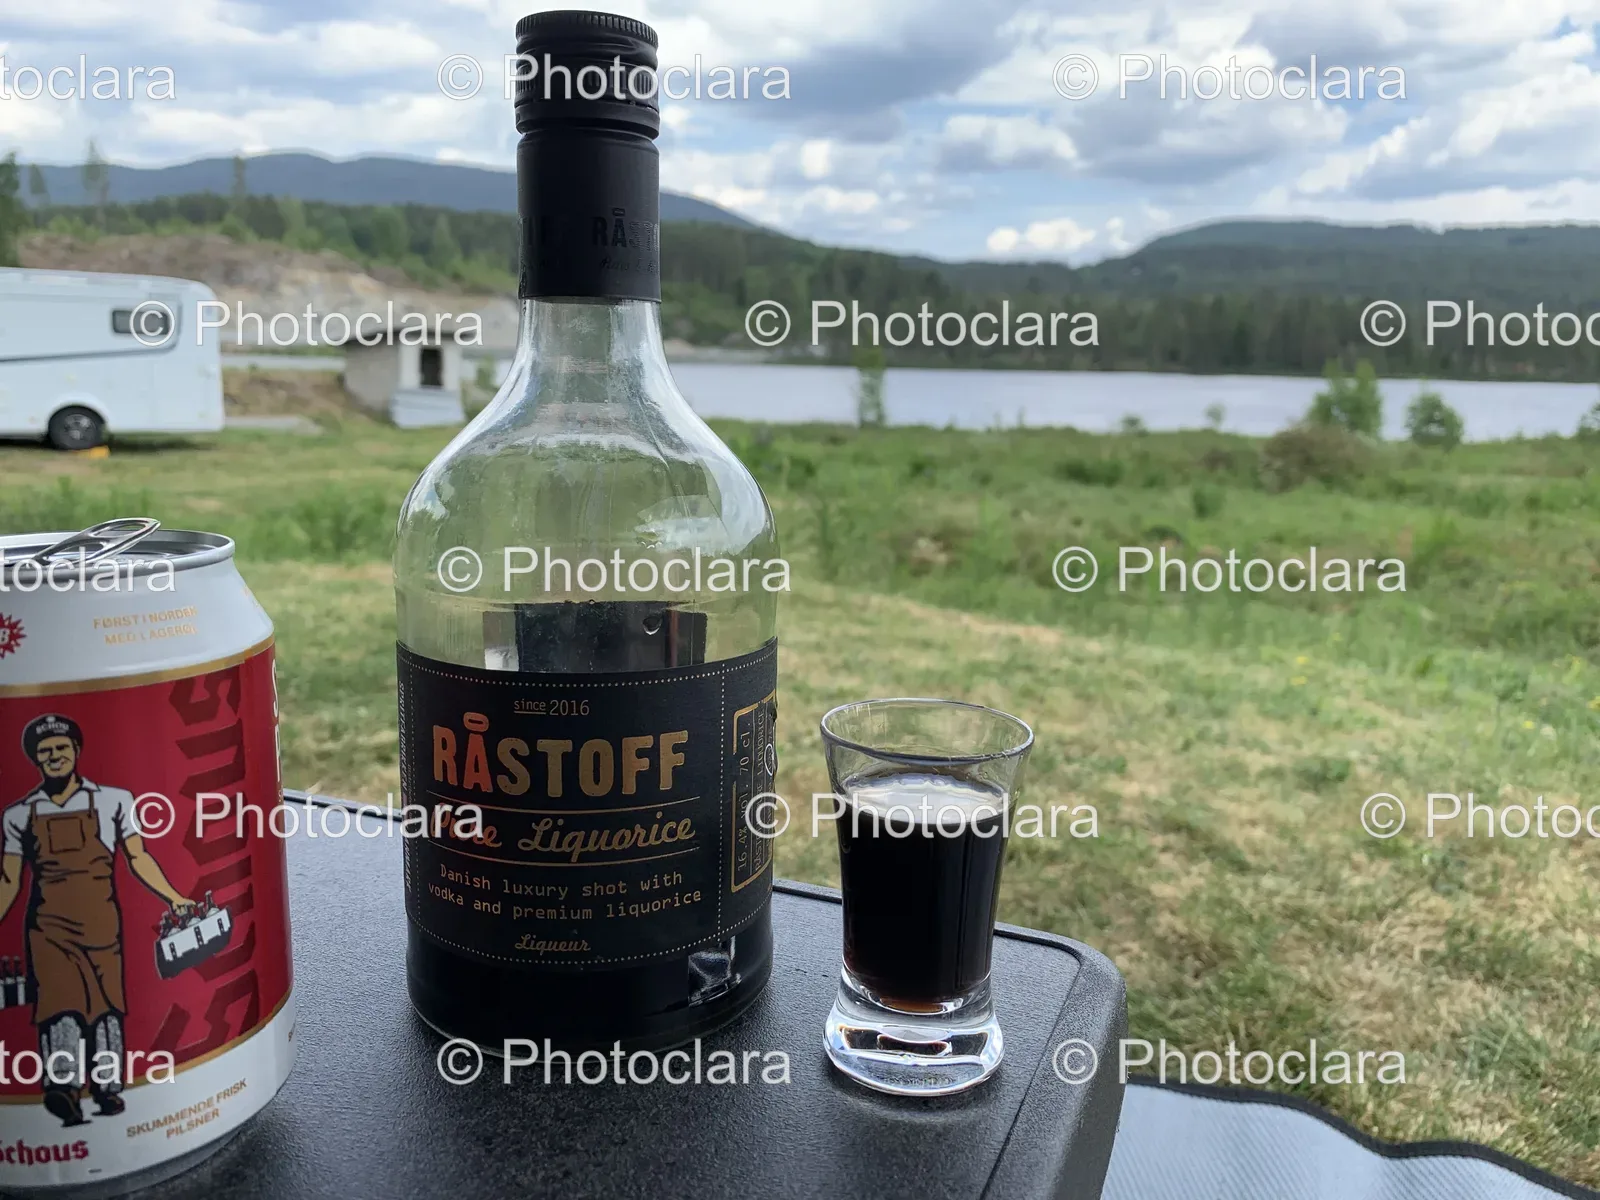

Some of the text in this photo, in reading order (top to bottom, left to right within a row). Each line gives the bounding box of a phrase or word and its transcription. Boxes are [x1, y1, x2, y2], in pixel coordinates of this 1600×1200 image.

[93, 614, 140, 630] FØRST
[104, 631, 136, 646] MED
[513, 698, 590, 716] since 2016
[740, 723, 751, 748] cl.
[432, 711, 689, 798] RÅSTOFF
[739, 756, 750, 776] 70
[430, 802, 696, 863] Pue Liquorice
[737, 826, 748, 872] 16.4%
[439, 863, 682, 900] Danish luxury shot with
[428, 883, 702, 920] vodka and premium liquorice
[514, 934, 592, 955] Liqueur
[126, 1077, 249, 1138] SKUMMENDE FRISK
[165, 1107, 221, 1139] PILSNER
[0, 1138, 89, 1166] chous
